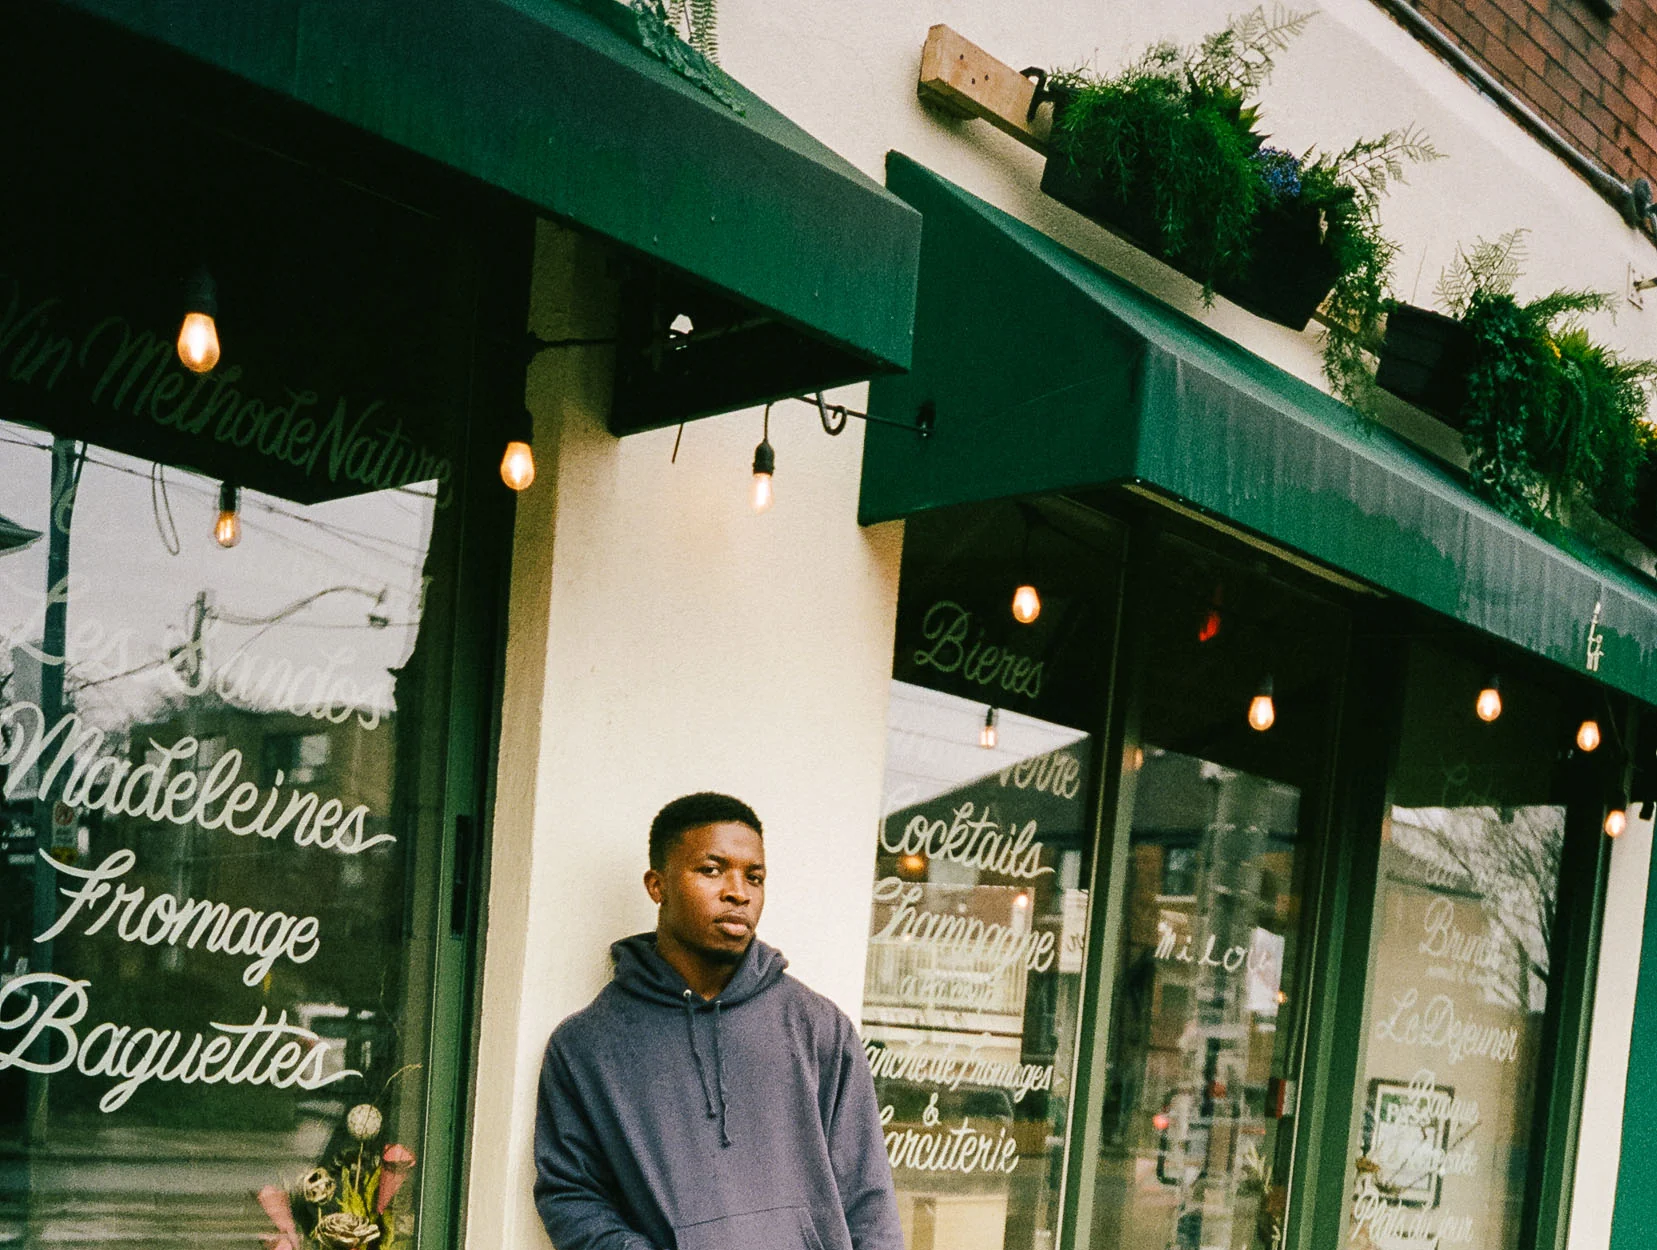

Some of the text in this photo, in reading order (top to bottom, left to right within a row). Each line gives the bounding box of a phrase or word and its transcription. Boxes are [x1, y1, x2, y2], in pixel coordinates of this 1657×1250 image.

[0, 700, 398, 854] Madeleines
[879, 785, 1056, 879] Cocktails
[33, 847, 321, 987] Fromage
[0, 972, 363, 1114] Baguettes
[862, 1036, 927, 1084] anche
[881, 1104, 1020, 1174] arcuterie
